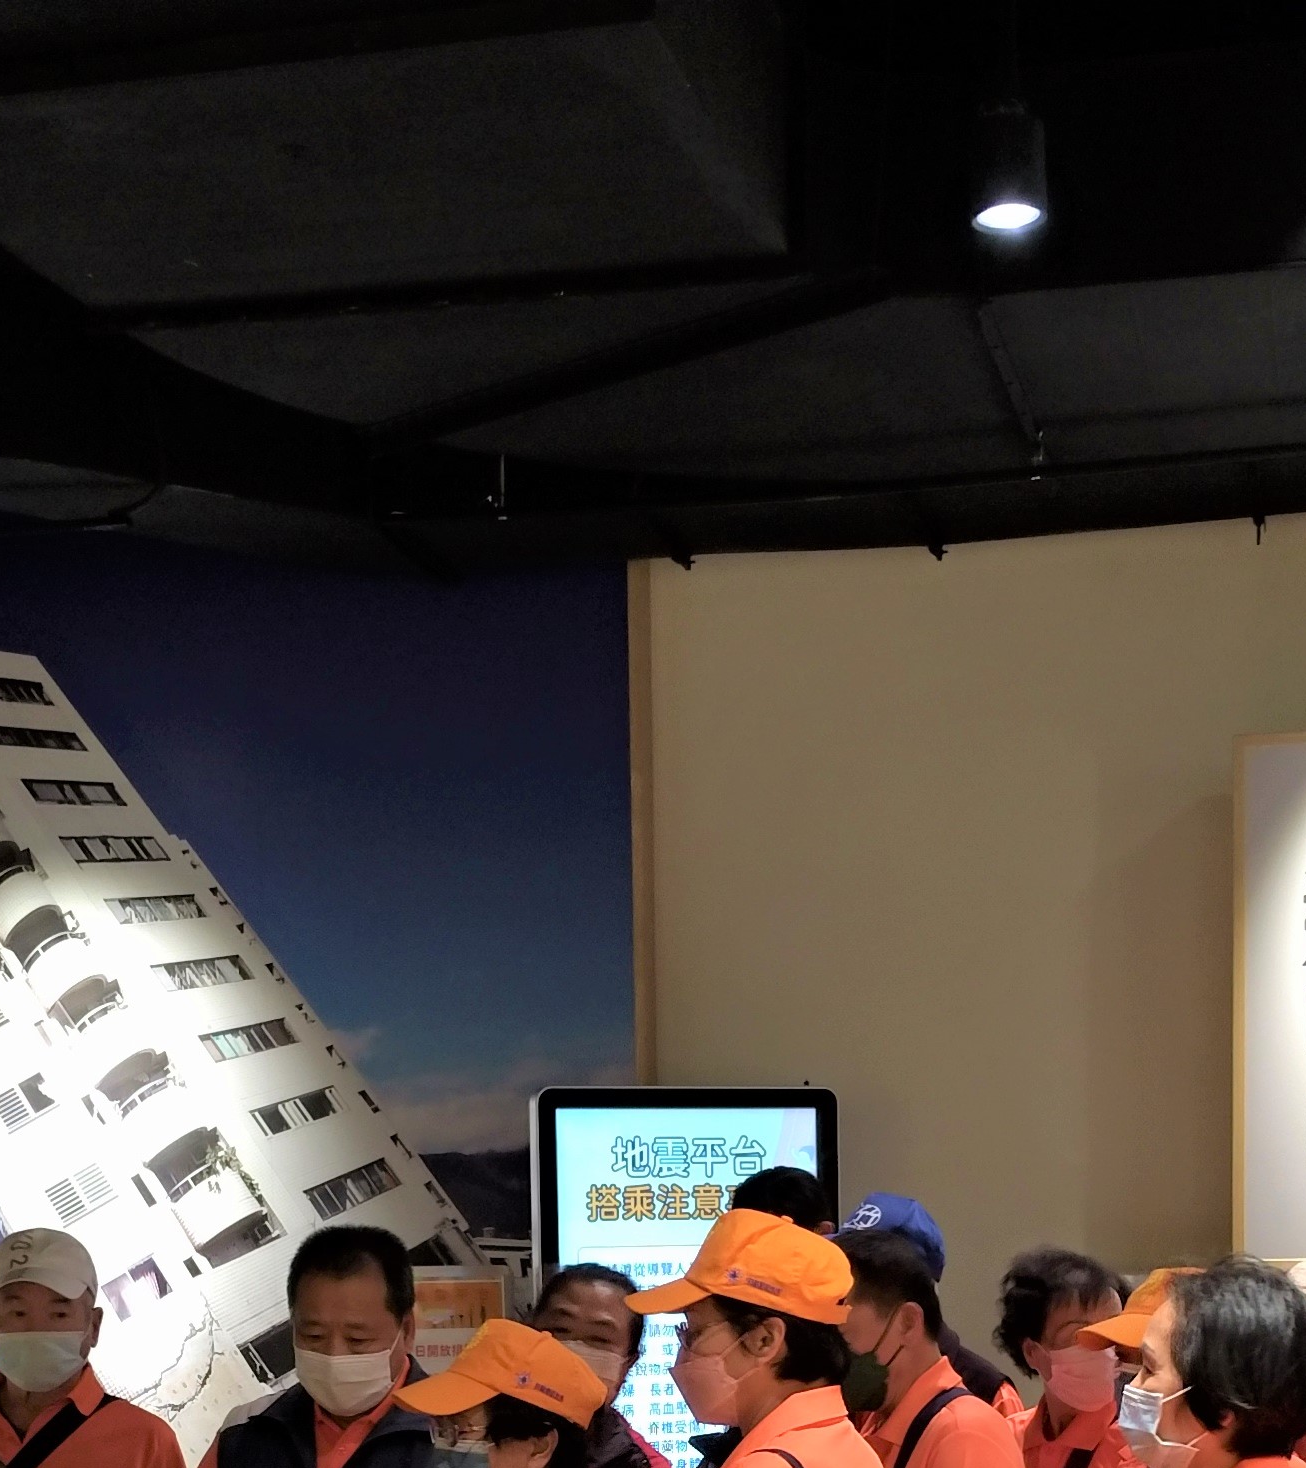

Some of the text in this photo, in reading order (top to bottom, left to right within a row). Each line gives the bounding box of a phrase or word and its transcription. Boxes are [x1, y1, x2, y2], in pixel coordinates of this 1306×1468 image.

[611, 1135, 767, 1178] 地震平台
[587, 1184, 733, 1222] 搭乘注意
